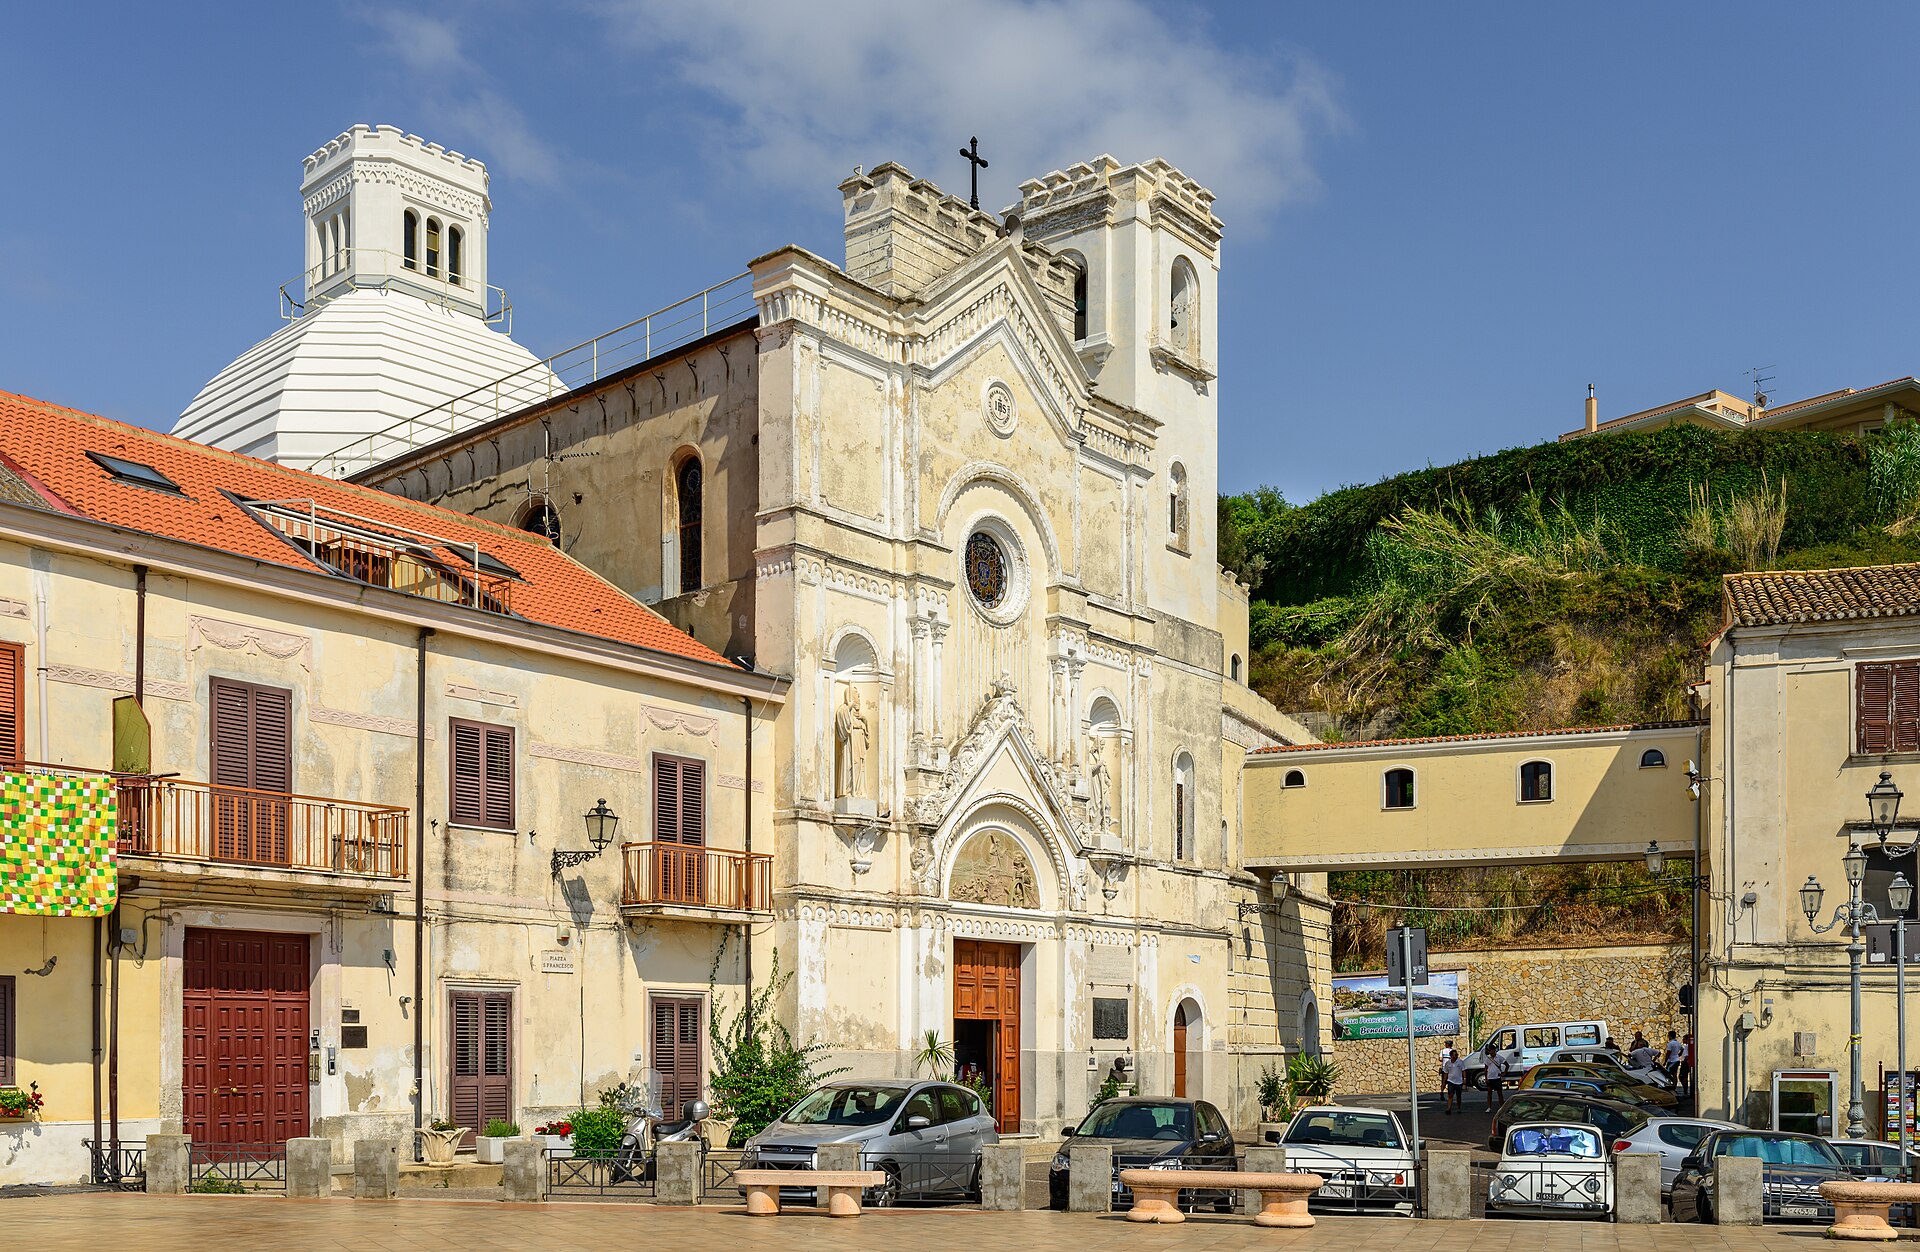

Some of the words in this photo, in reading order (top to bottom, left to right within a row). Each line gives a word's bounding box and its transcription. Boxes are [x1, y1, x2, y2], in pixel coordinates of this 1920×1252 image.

[1343, 1016, 1358, 1024] San
[1360, 1025, 1392, 1034] Benedici
[1434, 1022, 1454, 1030] Città
